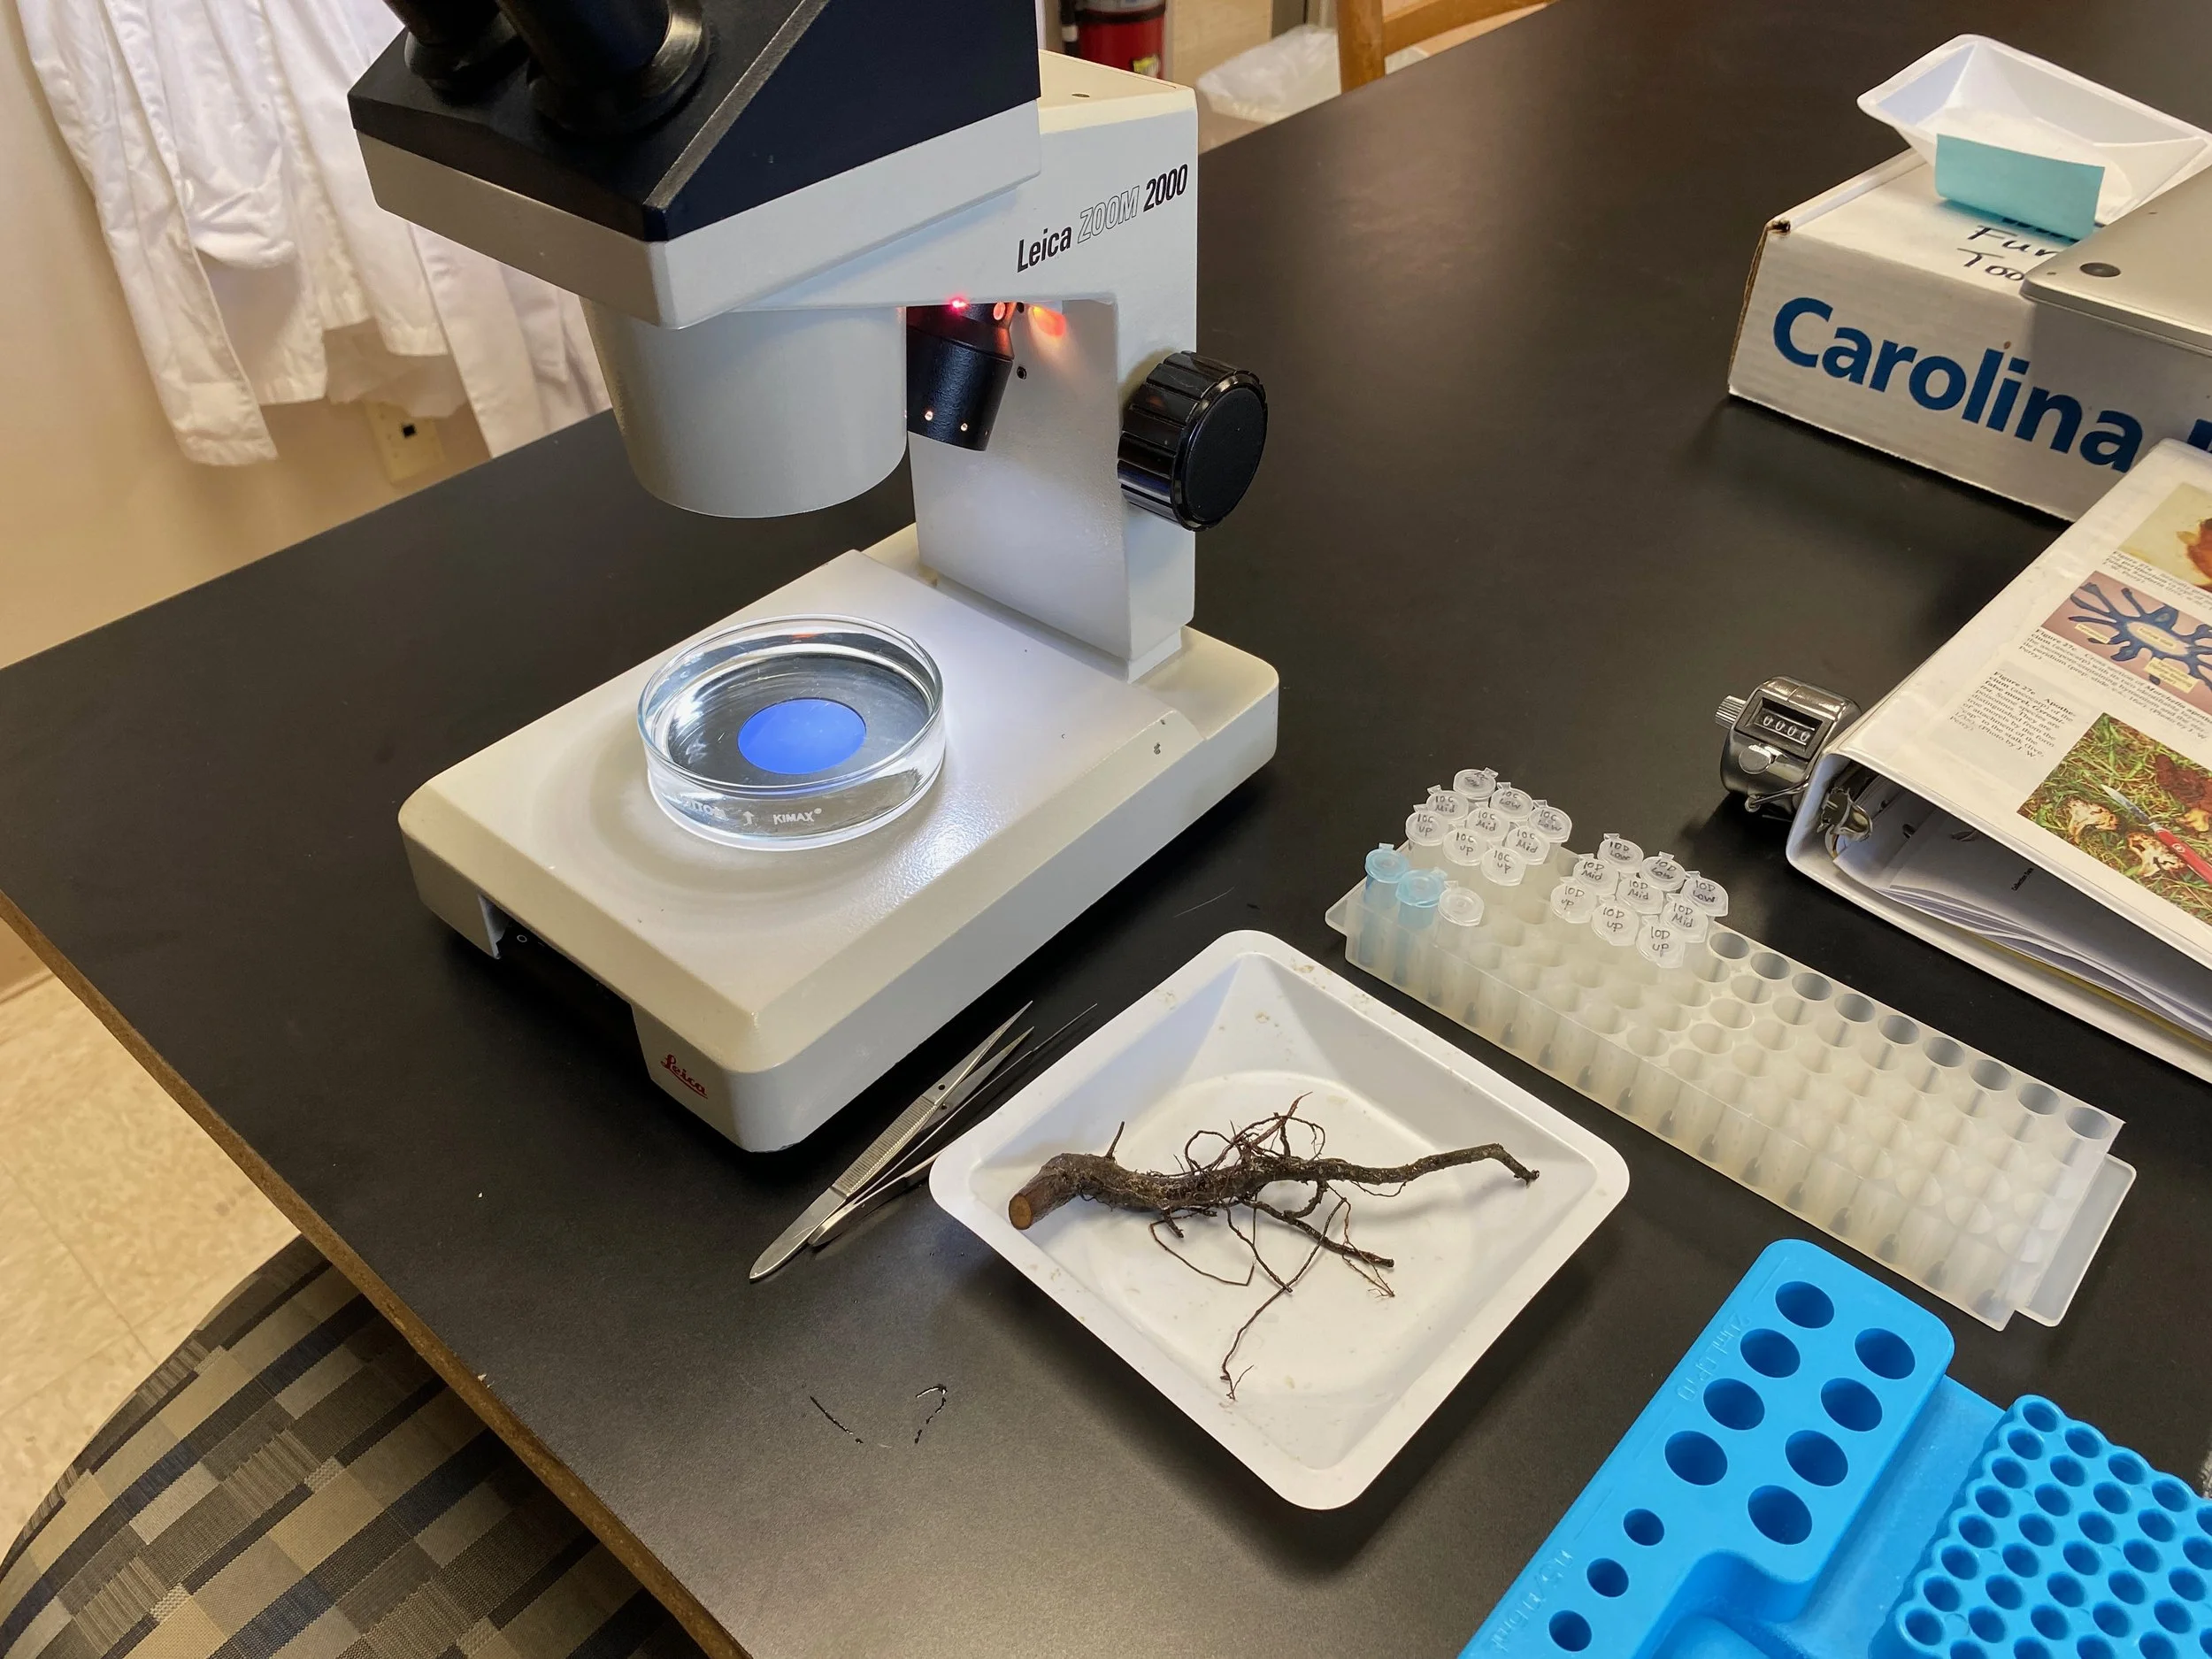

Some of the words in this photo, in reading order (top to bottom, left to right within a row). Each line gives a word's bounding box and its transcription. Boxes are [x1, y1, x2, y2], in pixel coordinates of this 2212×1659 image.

[1017, 227, 1071, 273] Leica
[1077, 185, 1141, 243] ZOOM
[1142, 164, 1188, 212] 2000
[1772, 296, 2143, 473] Carolina
[2035, 628, 2062, 643] Figure
[1985, 680, 2004, 692] false
[1993, 671, 2020, 687] Figure
[1971, 694, 2023, 723] distinguished
[2022, 720, 2042, 733] from
[2042, 732, 2055, 741] the
[1994, 692, 2017, 706] Some
[2018, 705, 2047, 722] species
[2047, 720, 2060, 729] are
[2018, 710, 2038, 724] They
[1763, 715, 1811, 742] 0000
[1967, 697, 1983, 708] true
[1983, 706, 2009, 723] morels
[2010, 720, 2021, 729] by
[2021, 727, 2034, 736] the
[2035, 734, 2055, 748] form
[1972, 708, 2015, 733] attachment
[2024, 736, 2038, 745] the
[1991, 724, 2003, 733] the
[2004, 732, 2023, 744] stalk
[1434, 803, 1455, 813] Mid
[1540, 810, 1557, 821] 10C
[1475, 819, 1496, 832] Mid
[1516, 839, 1539, 854] Mid
[1583, 861, 1605, 871] 10D
[1655, 859, 1678, 872] 10D
[1581, 870, 1603, 881] Mid
[1629, 879, 1648, 889] 10D
[1695, 879, 1716, 892] 10D
[1565, 886, 1586, 897] 10D
[1628, 888, 1649, 901] Mid
[1602, 907, 1625, 919] 10D
[1674, 902, 1694, 915] 10D
[1671, 913, 1694, 928] Mid
[1651, 926, 1671, 940] 10D
[659, 1054, 709, 1099] Leica
